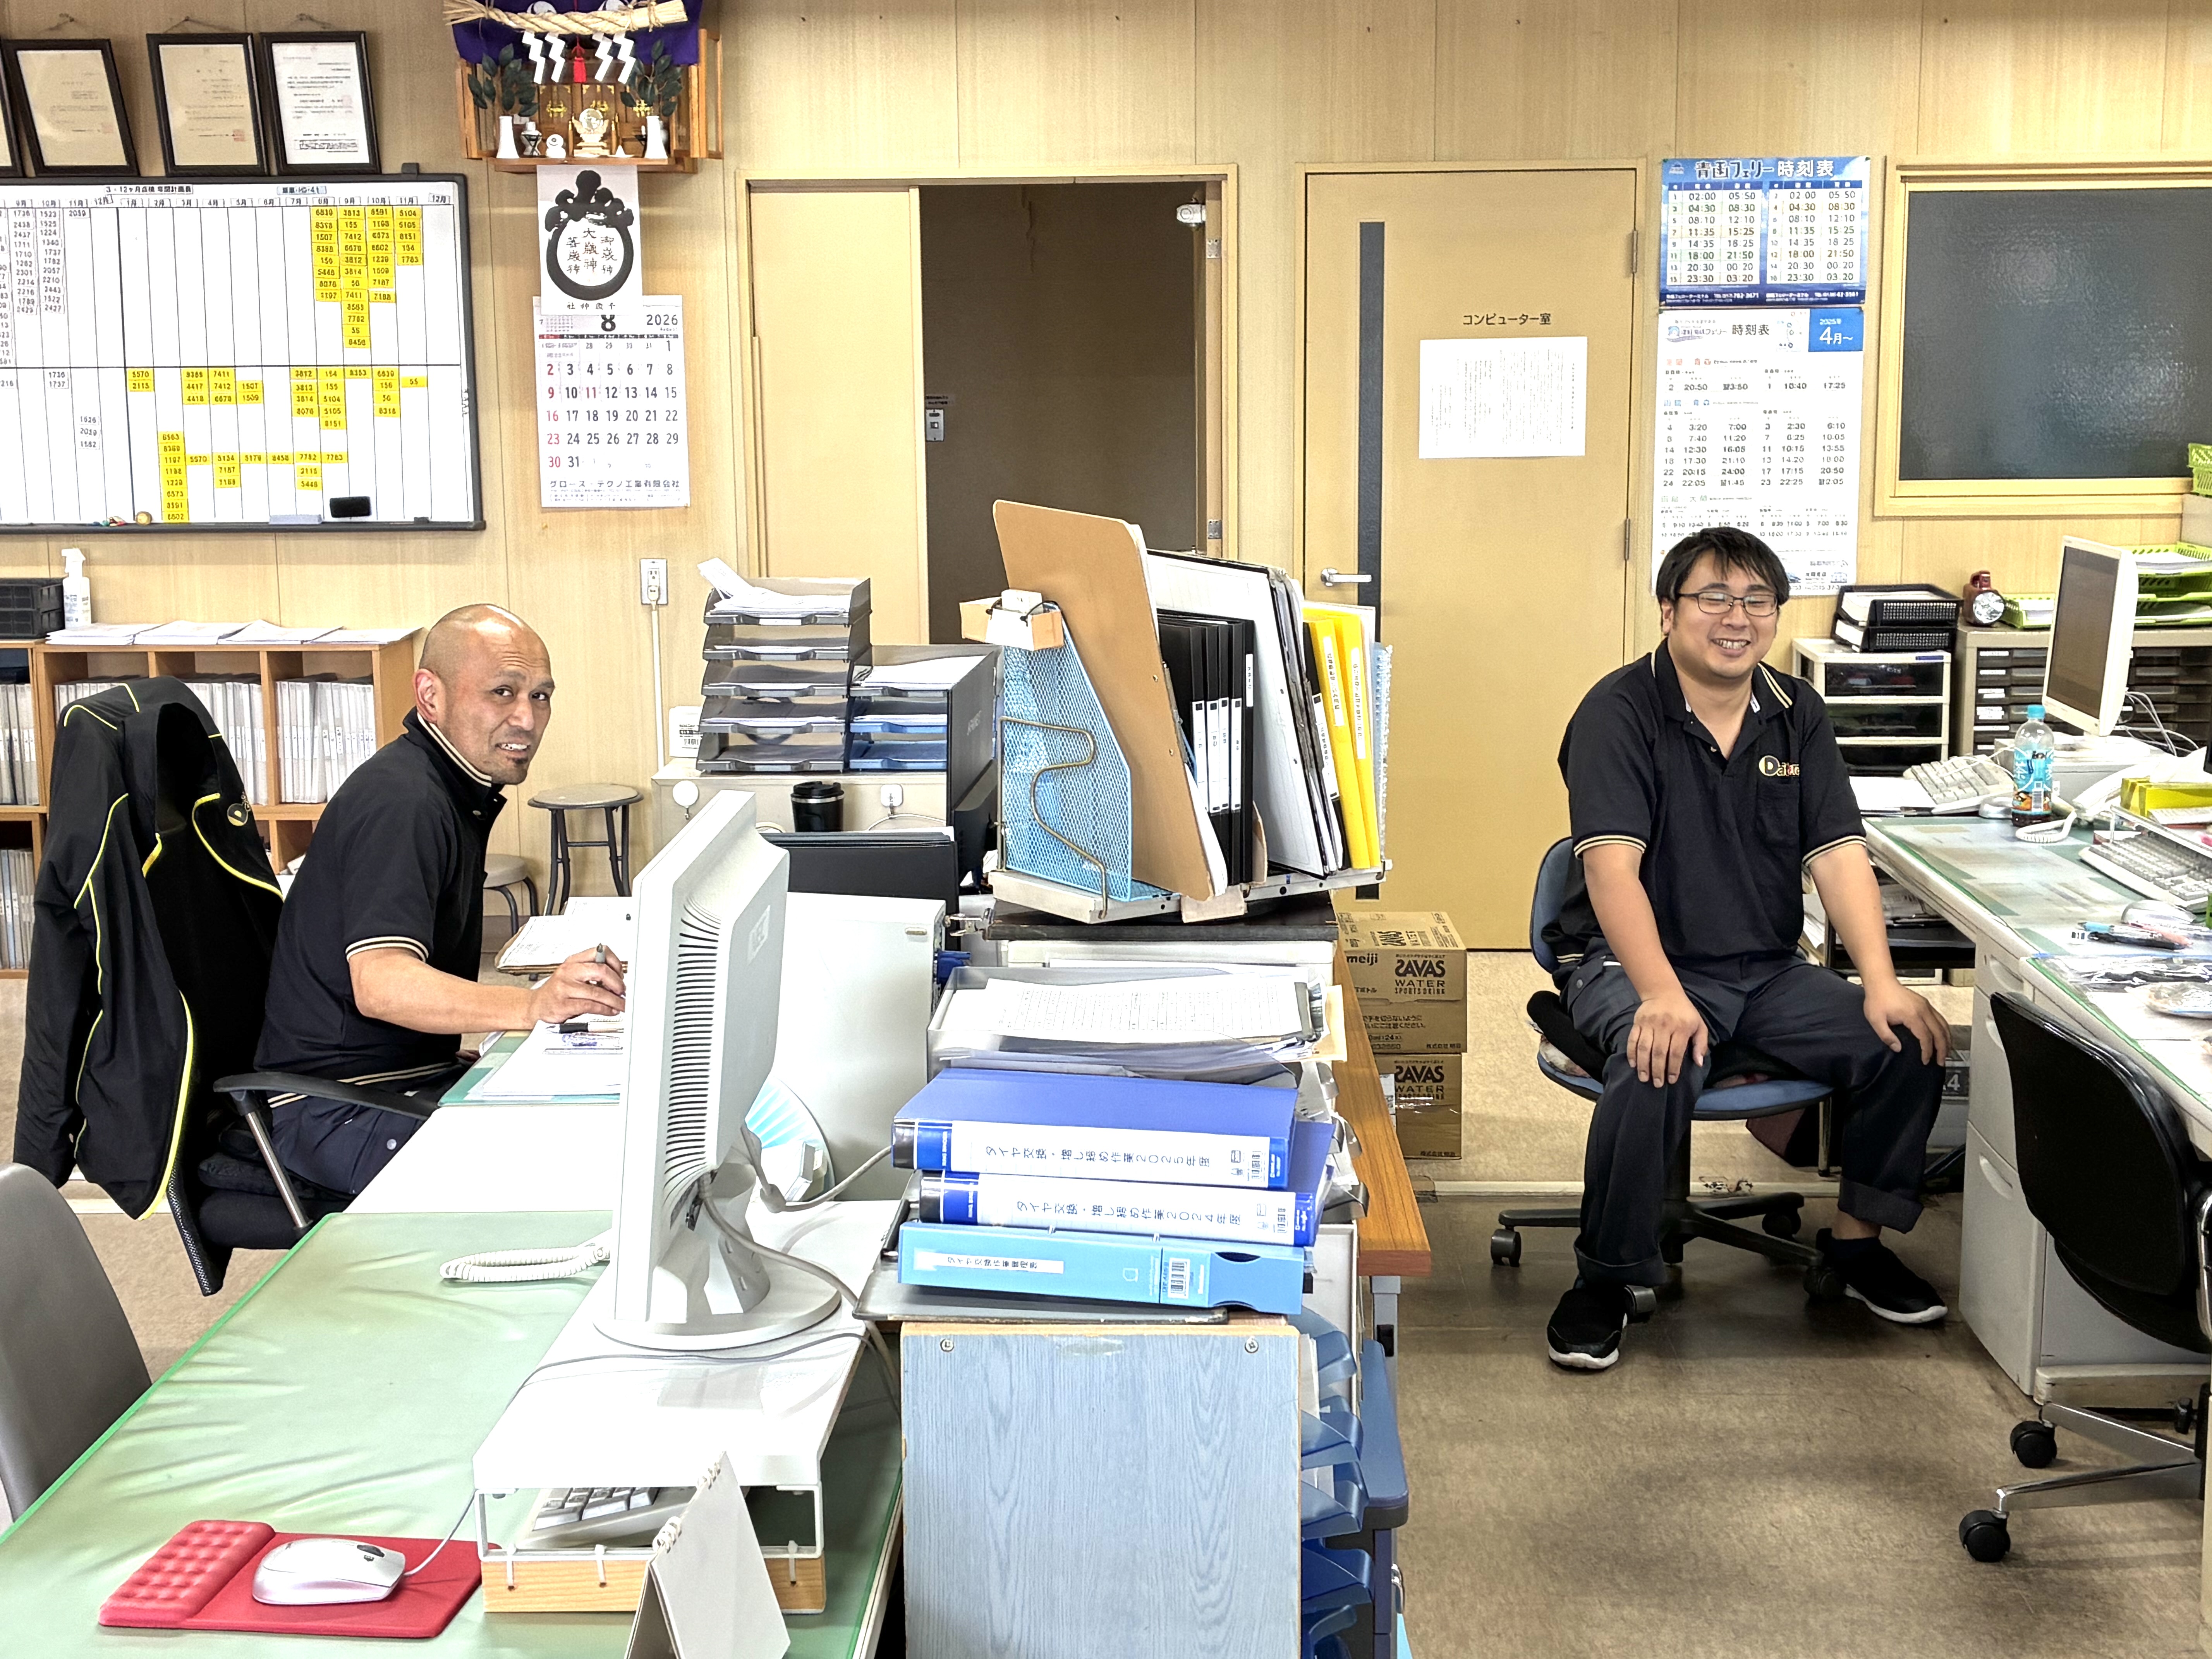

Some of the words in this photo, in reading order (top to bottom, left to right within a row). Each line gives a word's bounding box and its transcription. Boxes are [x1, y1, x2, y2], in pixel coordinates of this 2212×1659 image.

[1695, 160, 1774, 179] 青函フェリー
[1778, 160, 1834, 177] 時刻表
[1689, 192, 1716, 201] 02:00
[1688, 204, 1716, 213] 04:30
[1689, 228, 1715, 236] 11:35
[1790, 227, 1815, 235] 11:35
[1687, 275, 1714, 283] 23:30
[601, 314, 616, 331] 8
[646, 314, 678, 326] 2026
[1463, 313, 1551, 325] コンピューター室
[1732, 324, 1769, 335] 時刻表
[667, 341, 671, 351] 1
[547, 364, 554, 375] 2
[567, 364, 574, 375] 3
[587, 364, 594, 375] 4
[607, 364, 613, 375] 5
[627, 364, 633, 375] 6
[646, 364, 653, 375] 7
[666, 364, 673, 375] 8
[548, 386, 554, 398] 9
[565, 386, 577, 398] 10
[586, 386, 596, 398] 11
[605, 386, 618, 398] 12
[625, 386, 637, 398] 13
[646, 386, 658, 398] 14
[665, 386, 677, 398] 15
[546, 410, 558, 422] 16
[566, 410, 578, 422] 17
[586, 410, 599, 422] 18
[606, 410, 618, 422] 19
[626, 410, 638, 422] 20
[645, 410, 657, 422] 21
[665, 410, 678, 422] 22
[547, 433, 560, 445] 23
[567, 433, 580, 445] 24
[587, 433, 599, 445] 25
[607, 433, 619, 445] 26
[627, 433, 639, 445] 27
[646, 433, 658, 445] 28
[666, 433, 678, 445] 29
[548, 456, 560, 467] 30
[568, 456, 579, 467] 31
[1346, 953, 1378, 965] meiji
[1395, 959, 1446, 977] SAVAS
[1395, 1066, 1444, 1083] SAVAS
